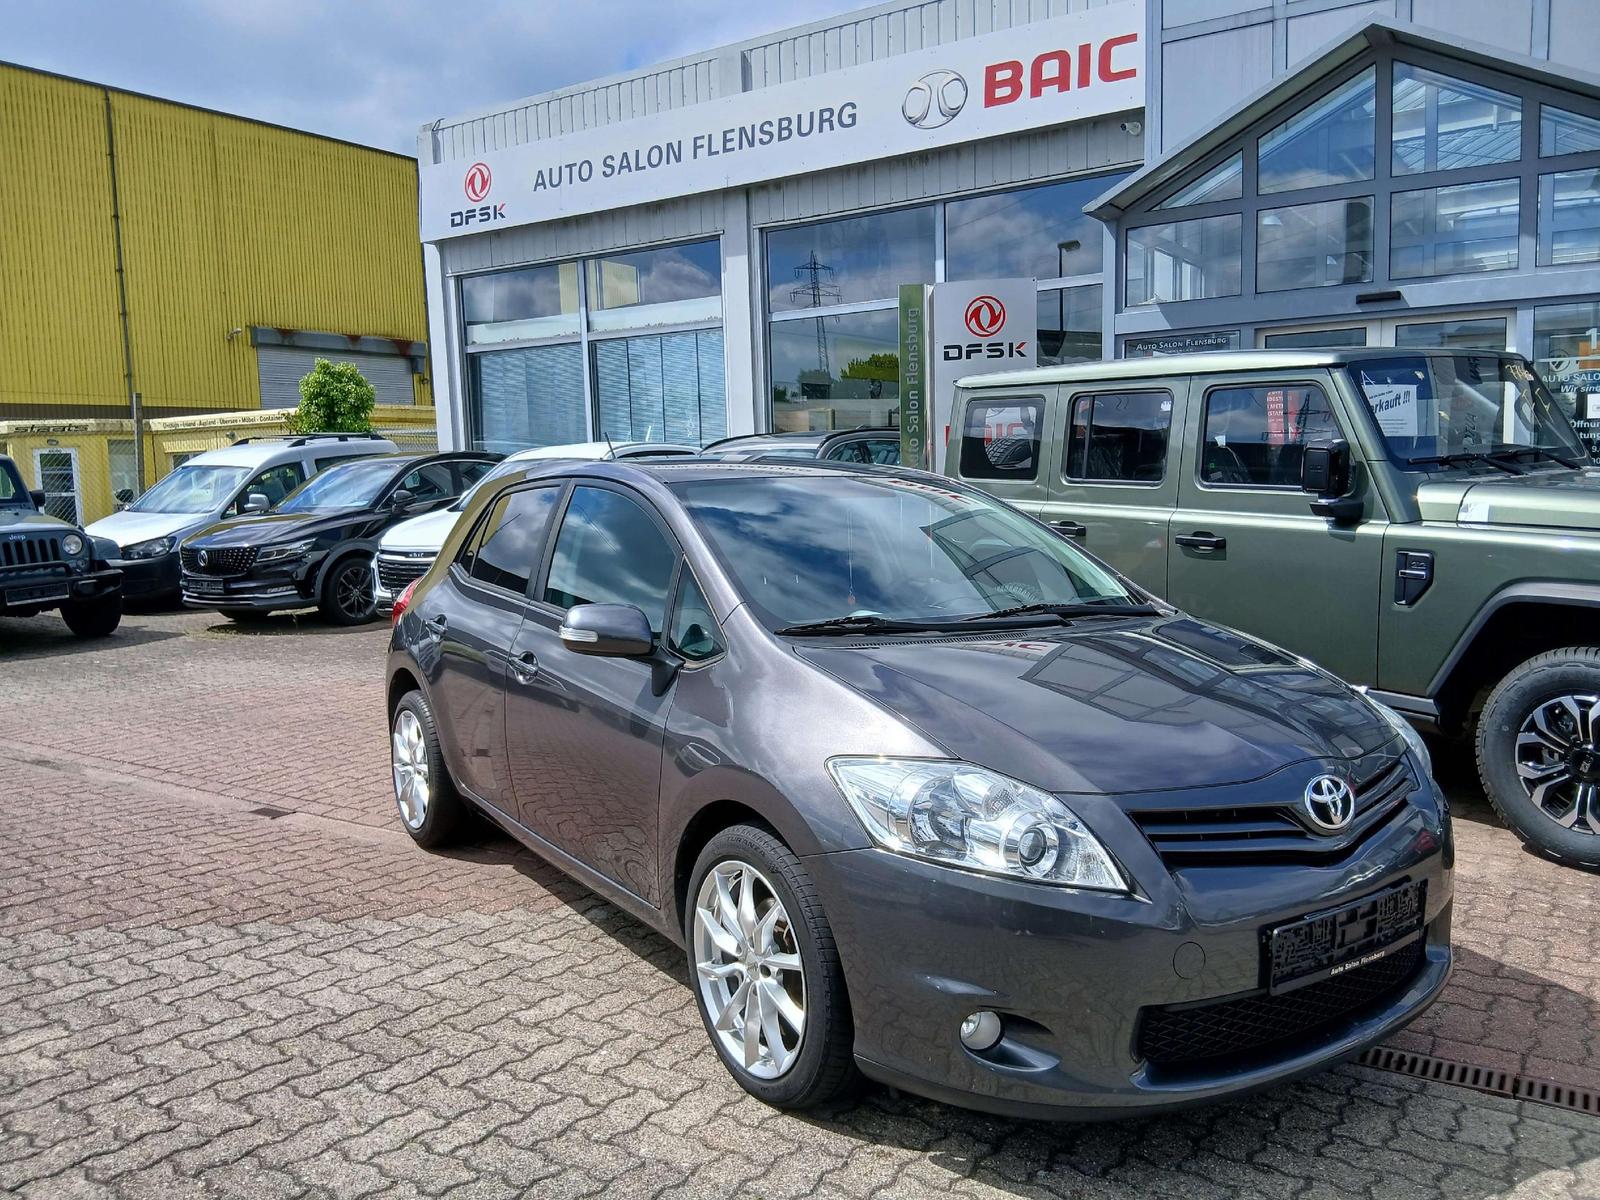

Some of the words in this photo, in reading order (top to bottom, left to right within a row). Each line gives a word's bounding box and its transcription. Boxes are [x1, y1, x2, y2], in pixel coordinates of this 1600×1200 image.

[984, 33, 1138, 108] BAIC
[533, 160, 593, 192] AUTO
[602, 140, 682, 178] SALON
[693, 102, 857, 160] FLENSBURG
[450, 203, 506, 228] DFSK
[906, 308, 921, 385] Flensburg
[943, 341, 1027, 362] DFSK
[906, 390, 919, 433] Salon
[1331, 966, 1343, 975] Auto
[1345, 961, 1359, 970] Salon
